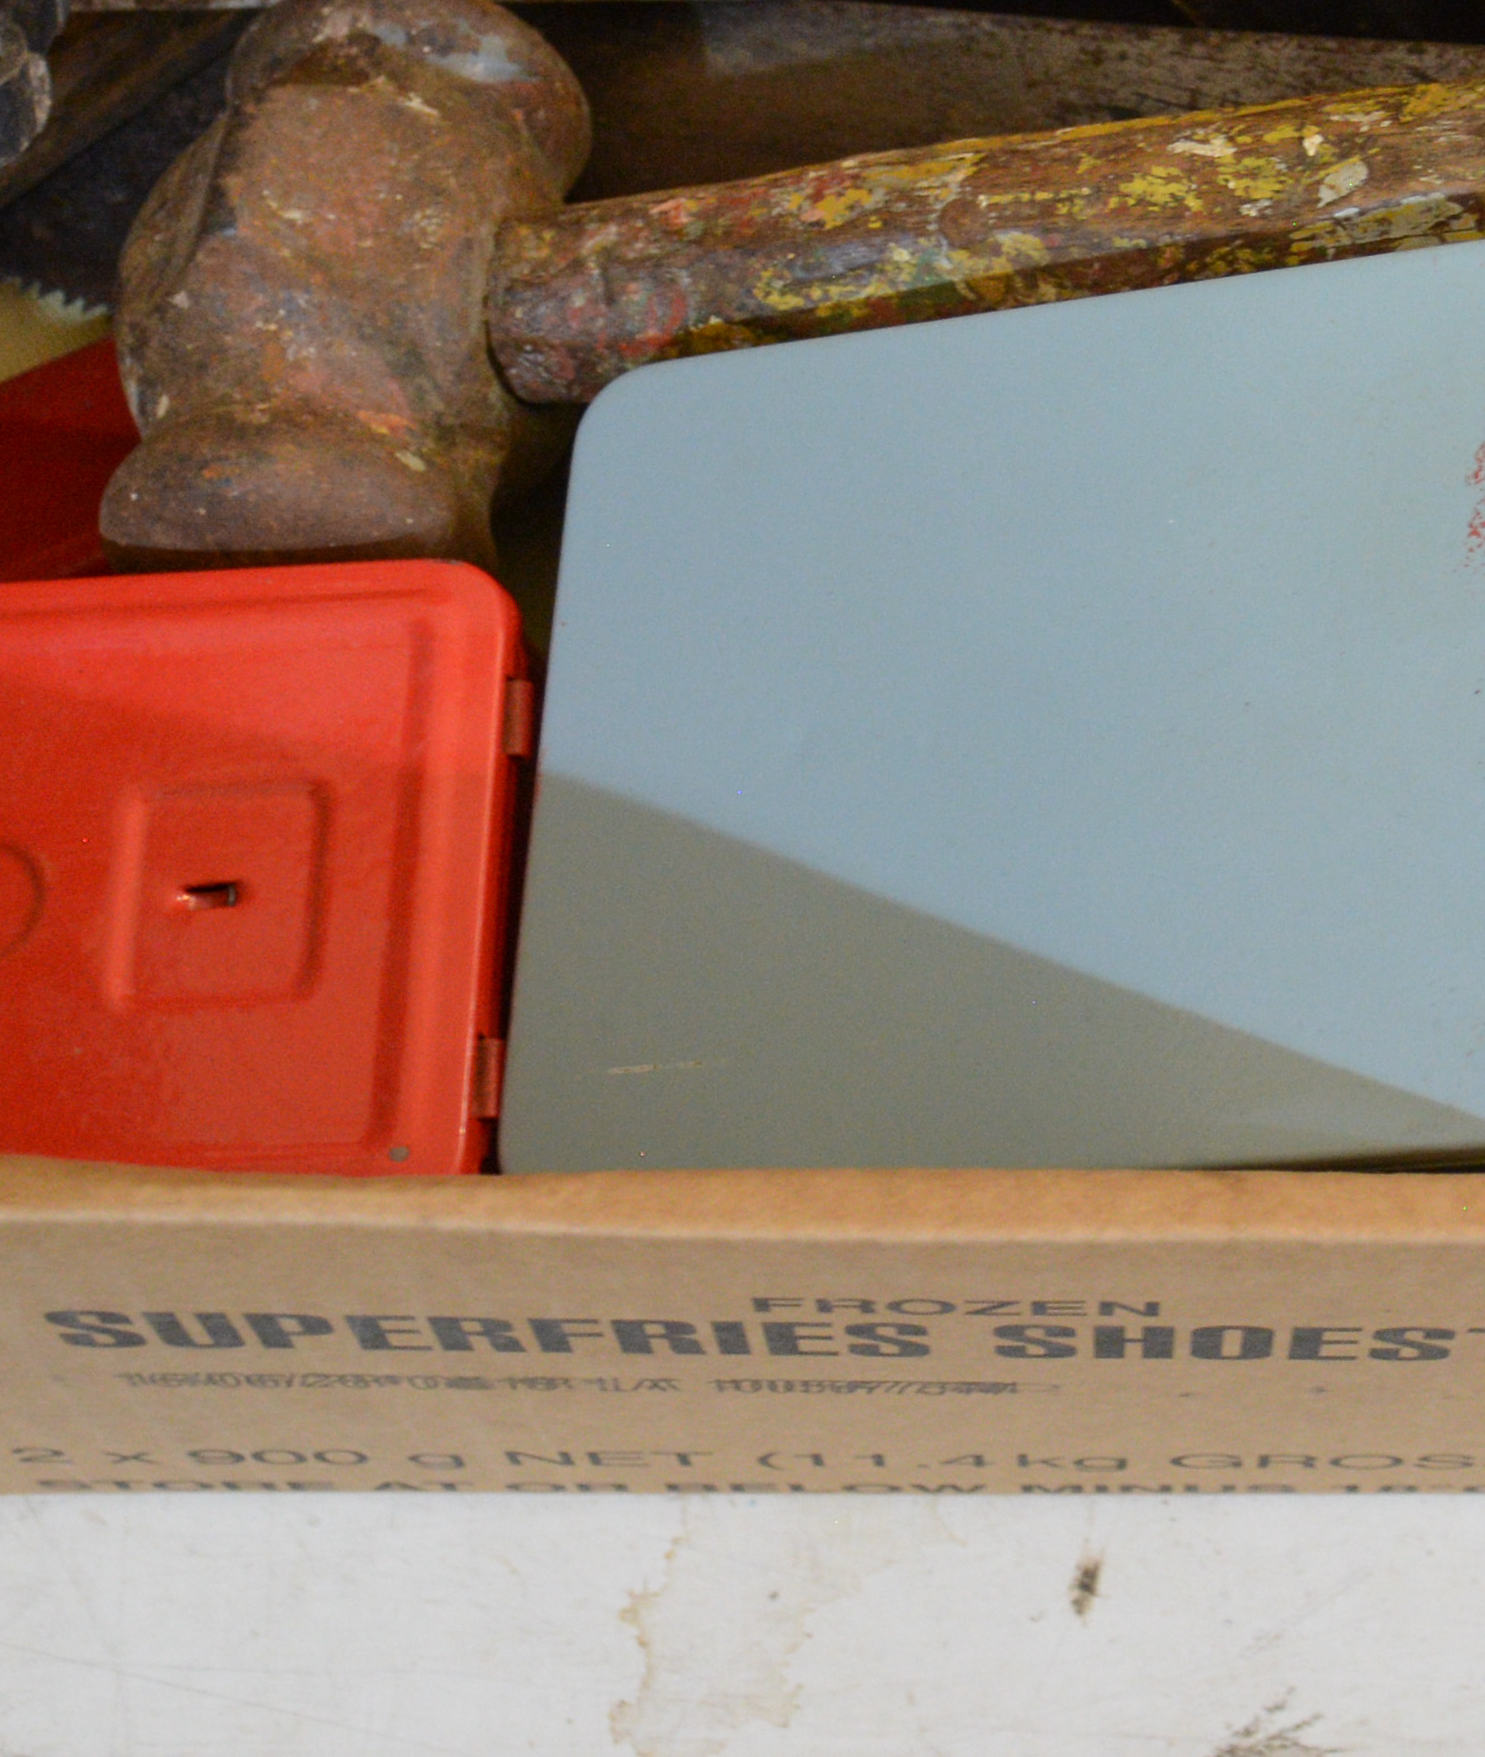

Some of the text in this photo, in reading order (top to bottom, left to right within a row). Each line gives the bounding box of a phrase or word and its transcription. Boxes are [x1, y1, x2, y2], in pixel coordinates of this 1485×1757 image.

[752, 1297, 1163, 1317] FROZEN
[45, 1308, 932, 1359] SUPERFRIES
[106, 1450, 159, 1466] x
[186, 1448, 371, 1467] 900
[503, 1450, 714, 1469] NET
[36, 1479, 335, 1492] STORE
[373, 1480, 475, 1492] AT
[664, 1481, 988, 1494] BELOW
